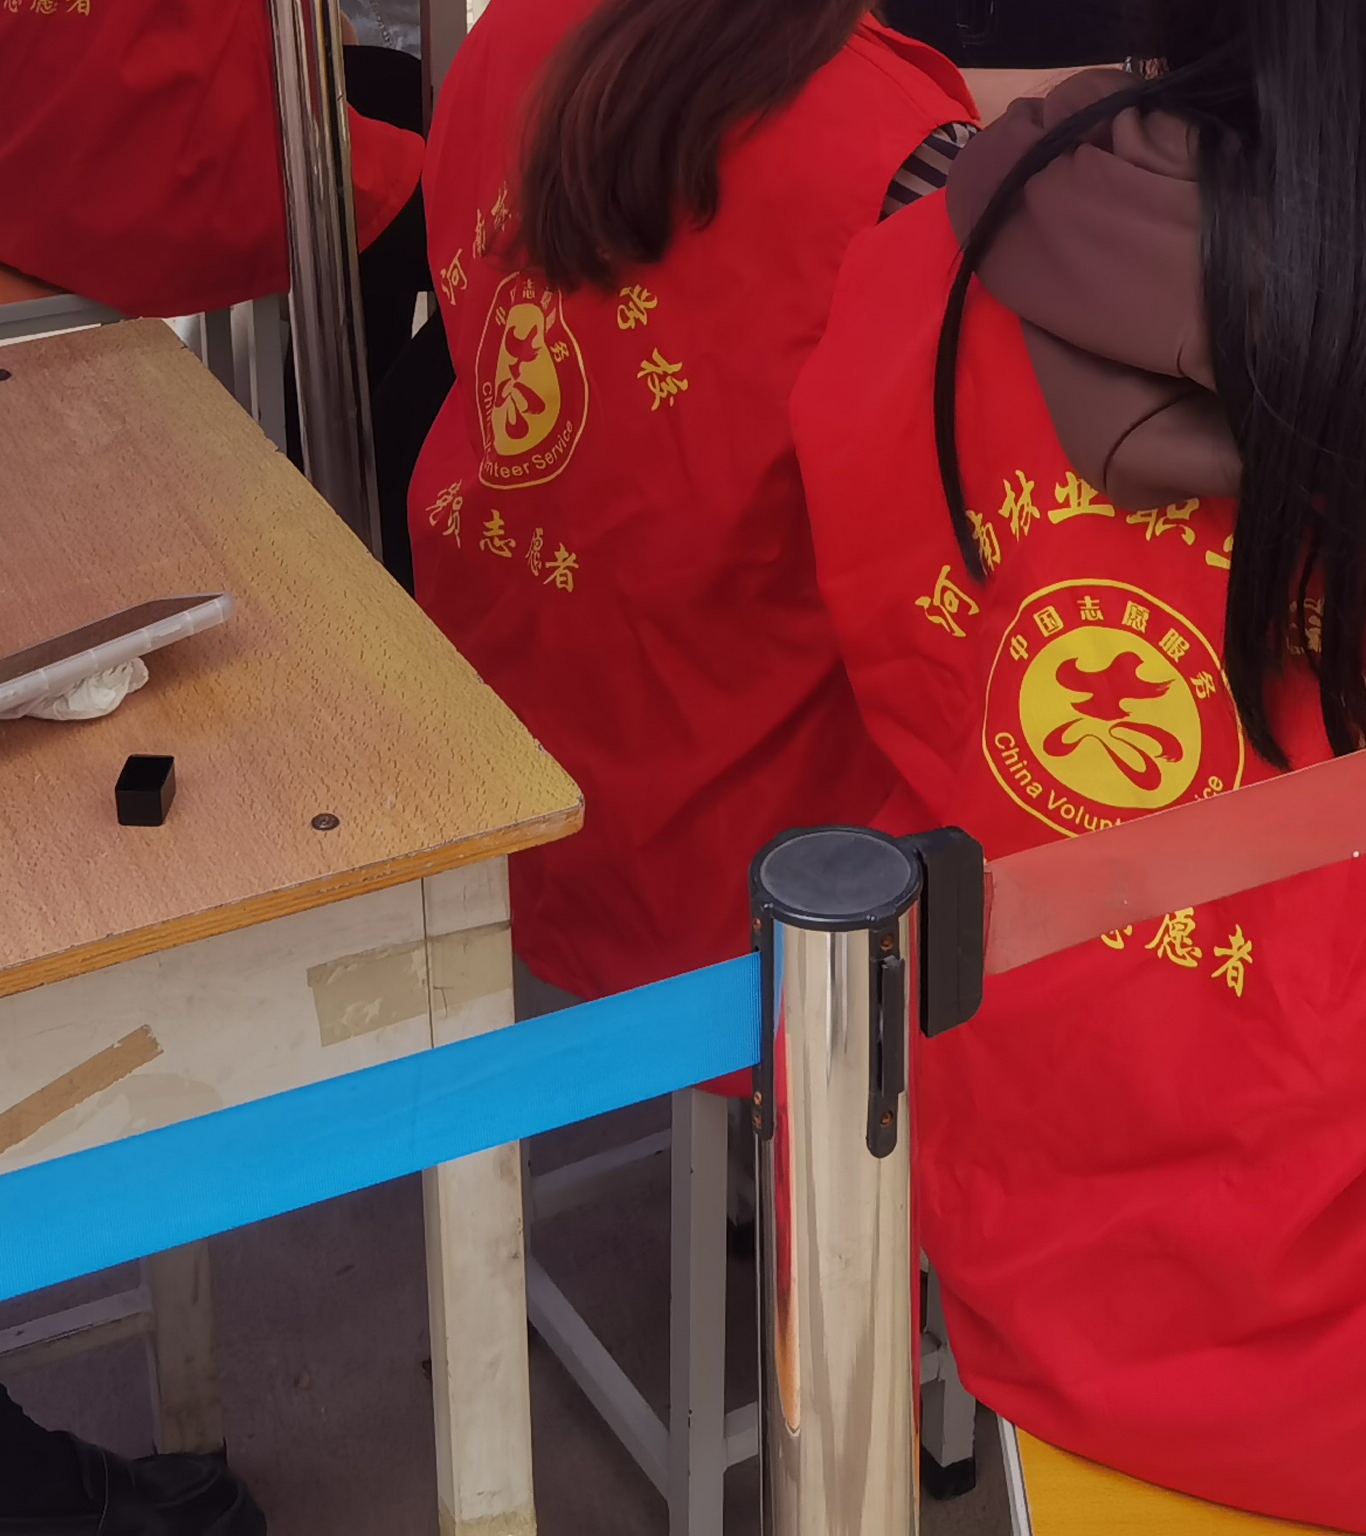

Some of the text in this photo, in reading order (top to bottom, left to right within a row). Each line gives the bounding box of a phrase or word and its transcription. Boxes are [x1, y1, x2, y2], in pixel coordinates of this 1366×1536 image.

[531, 420, 573, 470] Service
[1008, 596, 1216, 701] 中国志愿服务
[994, 731, 1043, 799] China
